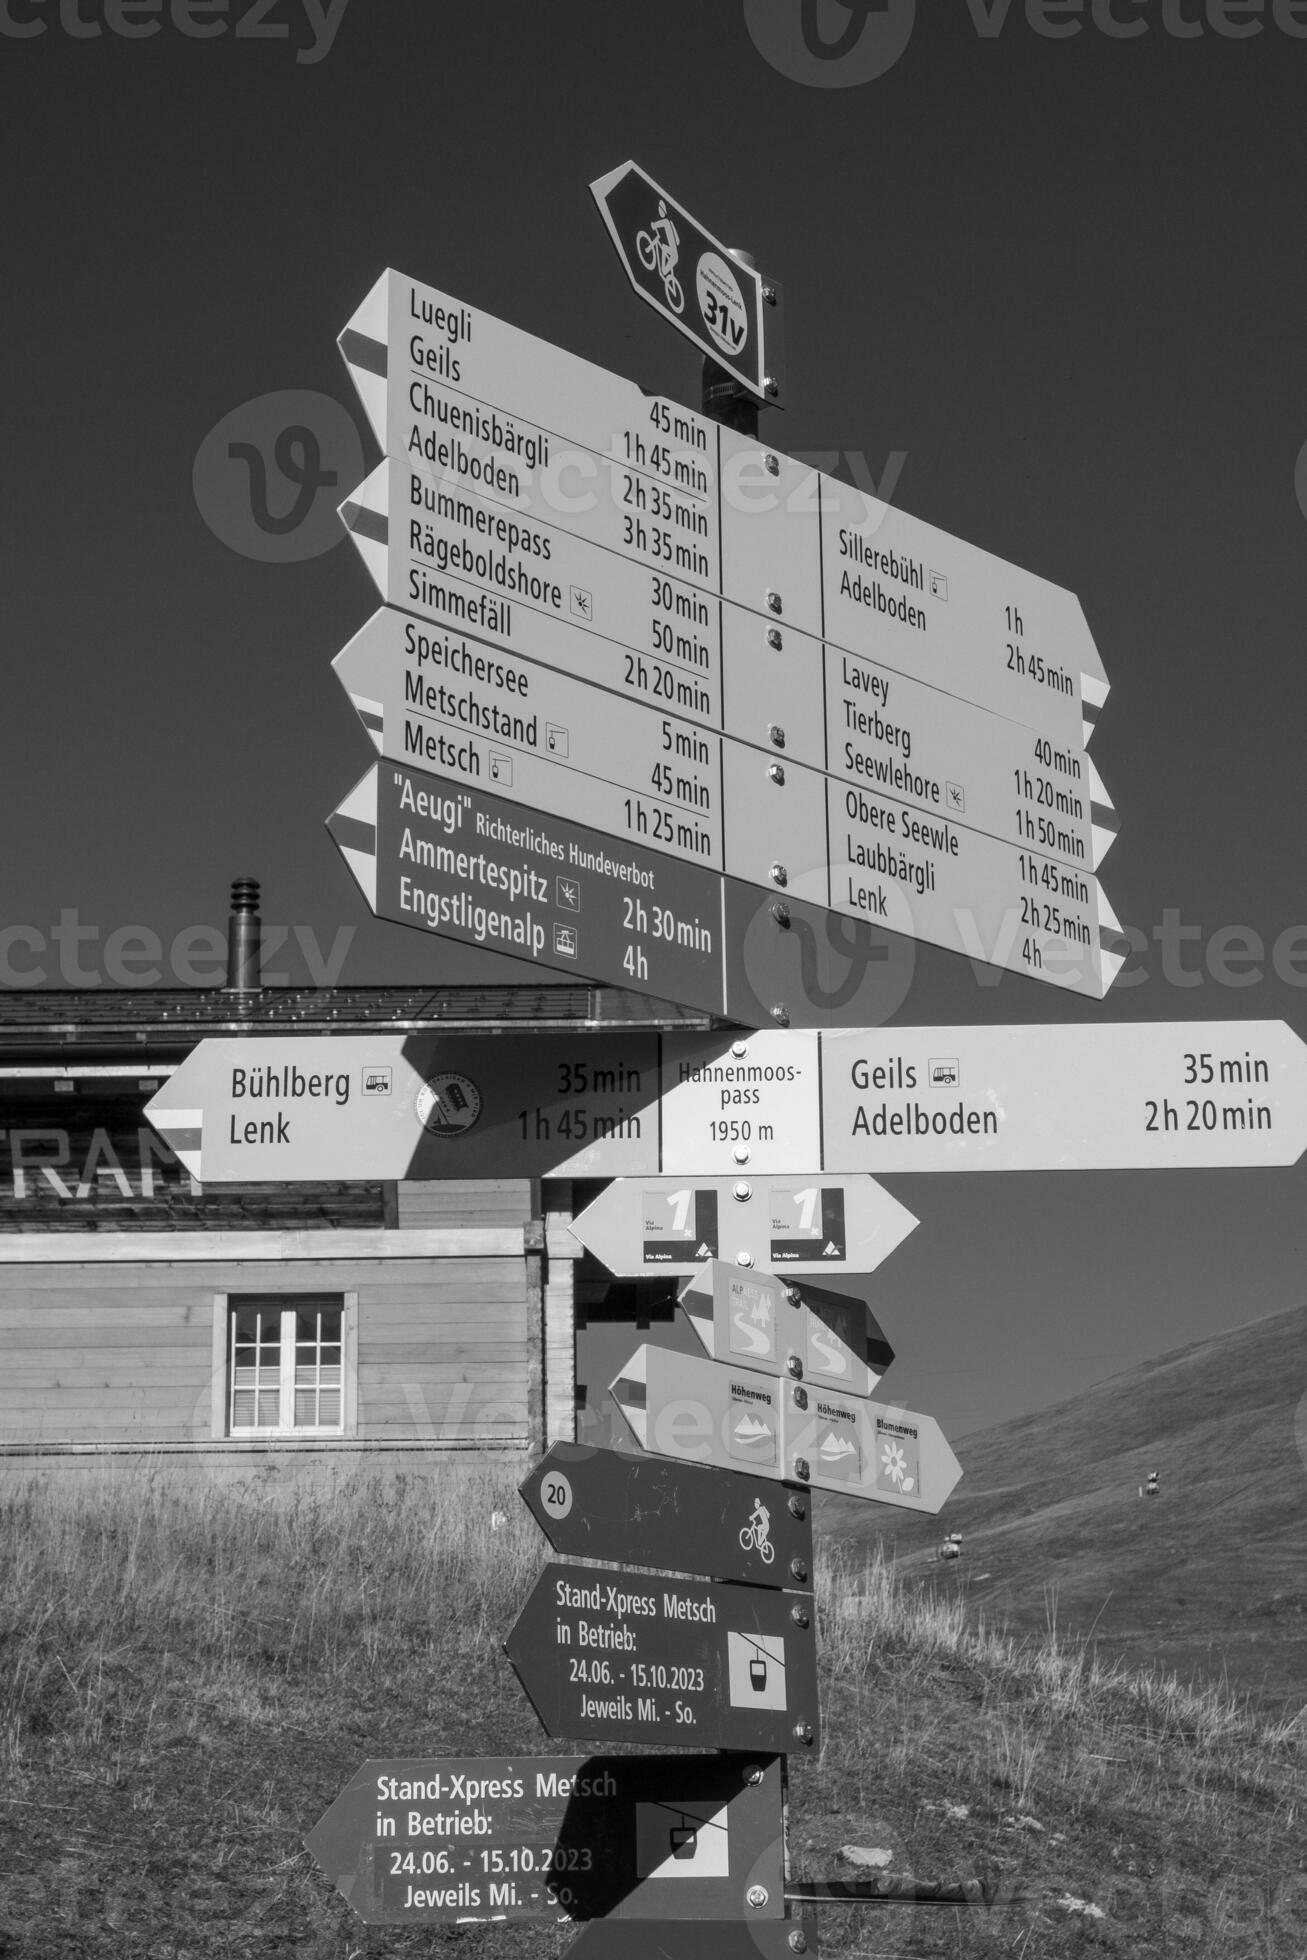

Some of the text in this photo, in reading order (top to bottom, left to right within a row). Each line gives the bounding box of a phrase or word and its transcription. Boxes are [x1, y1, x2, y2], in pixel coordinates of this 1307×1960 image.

[411, 288, 472, 343] Luegli
[409, 335, 461, 382] Geils
[409, 382, 549, 469] Chuenisbärgli
[408, 425, 520, 497] Adelboden
[410, 475, 551, 560] Bummerepass
[410, 519, 562, 608] Rägeboldshore
[839, 529, 924, 591] Sillerebühl
[409, 569, 511, 636] Simmefäll
[840, 570, 926, 631] Adelboden
[404, 623, 529, 698] Speichersee
[843, 657, 889, 701] Lavey
[405, 670, 537, 747] Metschstand
[843, 699, 911, 758] Tierberg
[404, 720, 480, 776] Metsch
[845, 743, 940, 803] Seewlehore
[394, 772, 655, 890] "Aeugi" Richterliches Hundeverbot
[846, 791, 959, 857] Obere Seewle
[399, 828, 548, 903] Ammertespitz
[847, 834, 935, 894] Laubbärgli
[400, 876, 545, 957] Engstligenalp
[848, 877, 888, 917] Lenk
[231, 1065, 350, 1106] Bühlberg
[679, 1061, 802, 1083] Hahnenmoos-
[851, 1056, 918, 1090] Geils
[721, 1088, 760, 1110] pass
[851, 1103, 998, 1137] Adelboden
[230, 1112, 291, 1145] Lenk
[709, 1120, 774, 1142] 1950 m
[667, 1189, 692, 1231] 1
[793, 1188, 818, 1229] 1
[731, 1384, 772, 1406] Höhenweg
[817, 1403, 856, 1423] Höhenweg
[876, 1418, 918, 1439] Blumenweg
[547, 1484, 566, 1506] 20
[556, 1580, 716, 1623] Stand-Xpress Metsch
[557, 1617, 637, 1651] in Betrieb:
[569, 1659, 615, 1685] 24.06.
[631, 1663, 704, 1691] 15.10.2023
[580, 1694, 633, 1721] Jeweils
[637, 1698, 660, 1722] Mi.
[676, 1700, 697, 1724] So.
[377, 1771, 617, 1806] Stand-Xpress Metsch
[376, 1810, 493, 1837] in Betrieb:
[390, 1851, 455, 1876] 24.06.
[480, 1848, 593, 1873] 15.10.2023
[404, 1883, 481, 1909] Jeweils
[489, 1884, 523, 1906] Mi.
[547, 1881, 579, 1906] So.
